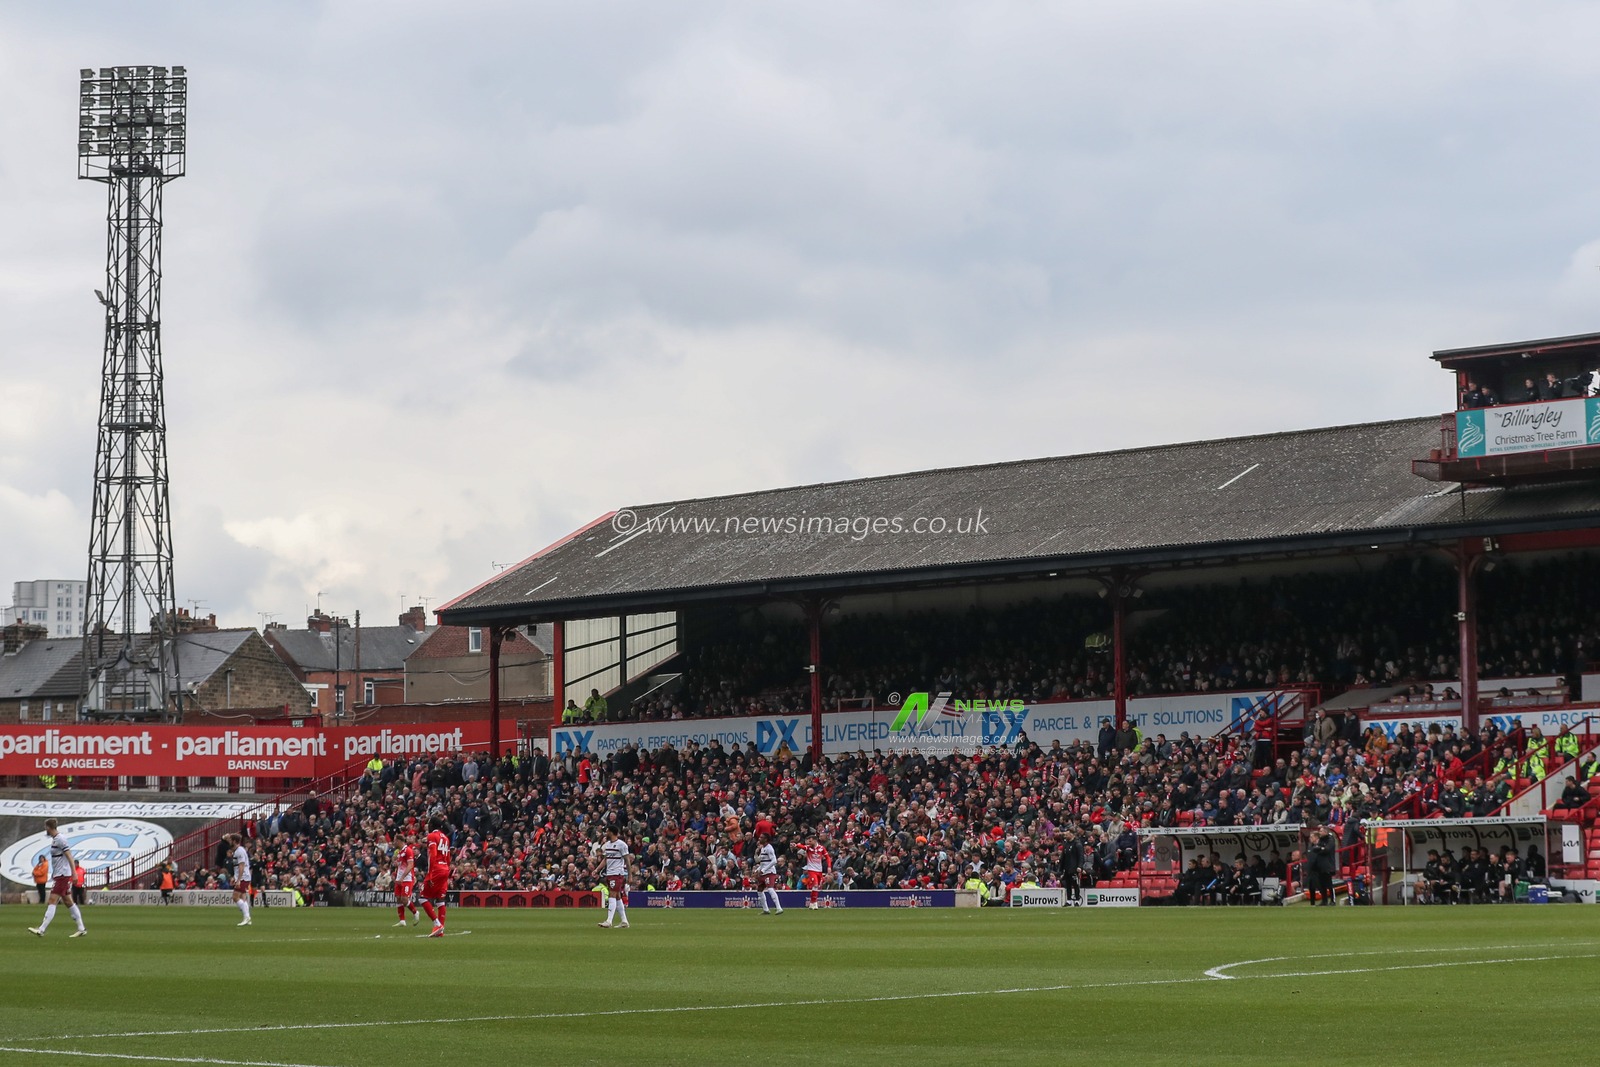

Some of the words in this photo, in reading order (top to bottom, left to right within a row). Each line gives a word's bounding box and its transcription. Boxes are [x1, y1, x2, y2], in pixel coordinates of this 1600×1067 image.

[1501, 406, 1562, 429] Billingley
[1495, 434, 1535, 445] Christmas
[1537, 432, 1554, 441] Tree
[1555, 430, 1577, 439] Farm
[1033, 715, 1079, 731] PARCEL
[1083, 714, 1092, 728] &
[1153, 709, 1224, 726] SOLUTIONS
[1542, 711, 1599, 726] PARCEL
[648, 734, 689, 748] FREIGHT
[693, 731, 749, 746] SOLUTIONS
[756, 718, 799, 753] DX
[805, 721, 889, 743] DLIVERED
[0, 729, 152, 760] parliament
[176, 731, 327, 760] parliament
[344, 727, 463, 760] parliament
[35, 758, 59, 769] LOS
[61, 758, 115, 769] ANGELES
[227, 760, 289, 771] BARNSLEY
[99, 893, 134, 907] Hayselden
[1023, 895, 1059, 905] Burrows
[1099, 894, 1137, 903] Burrows
